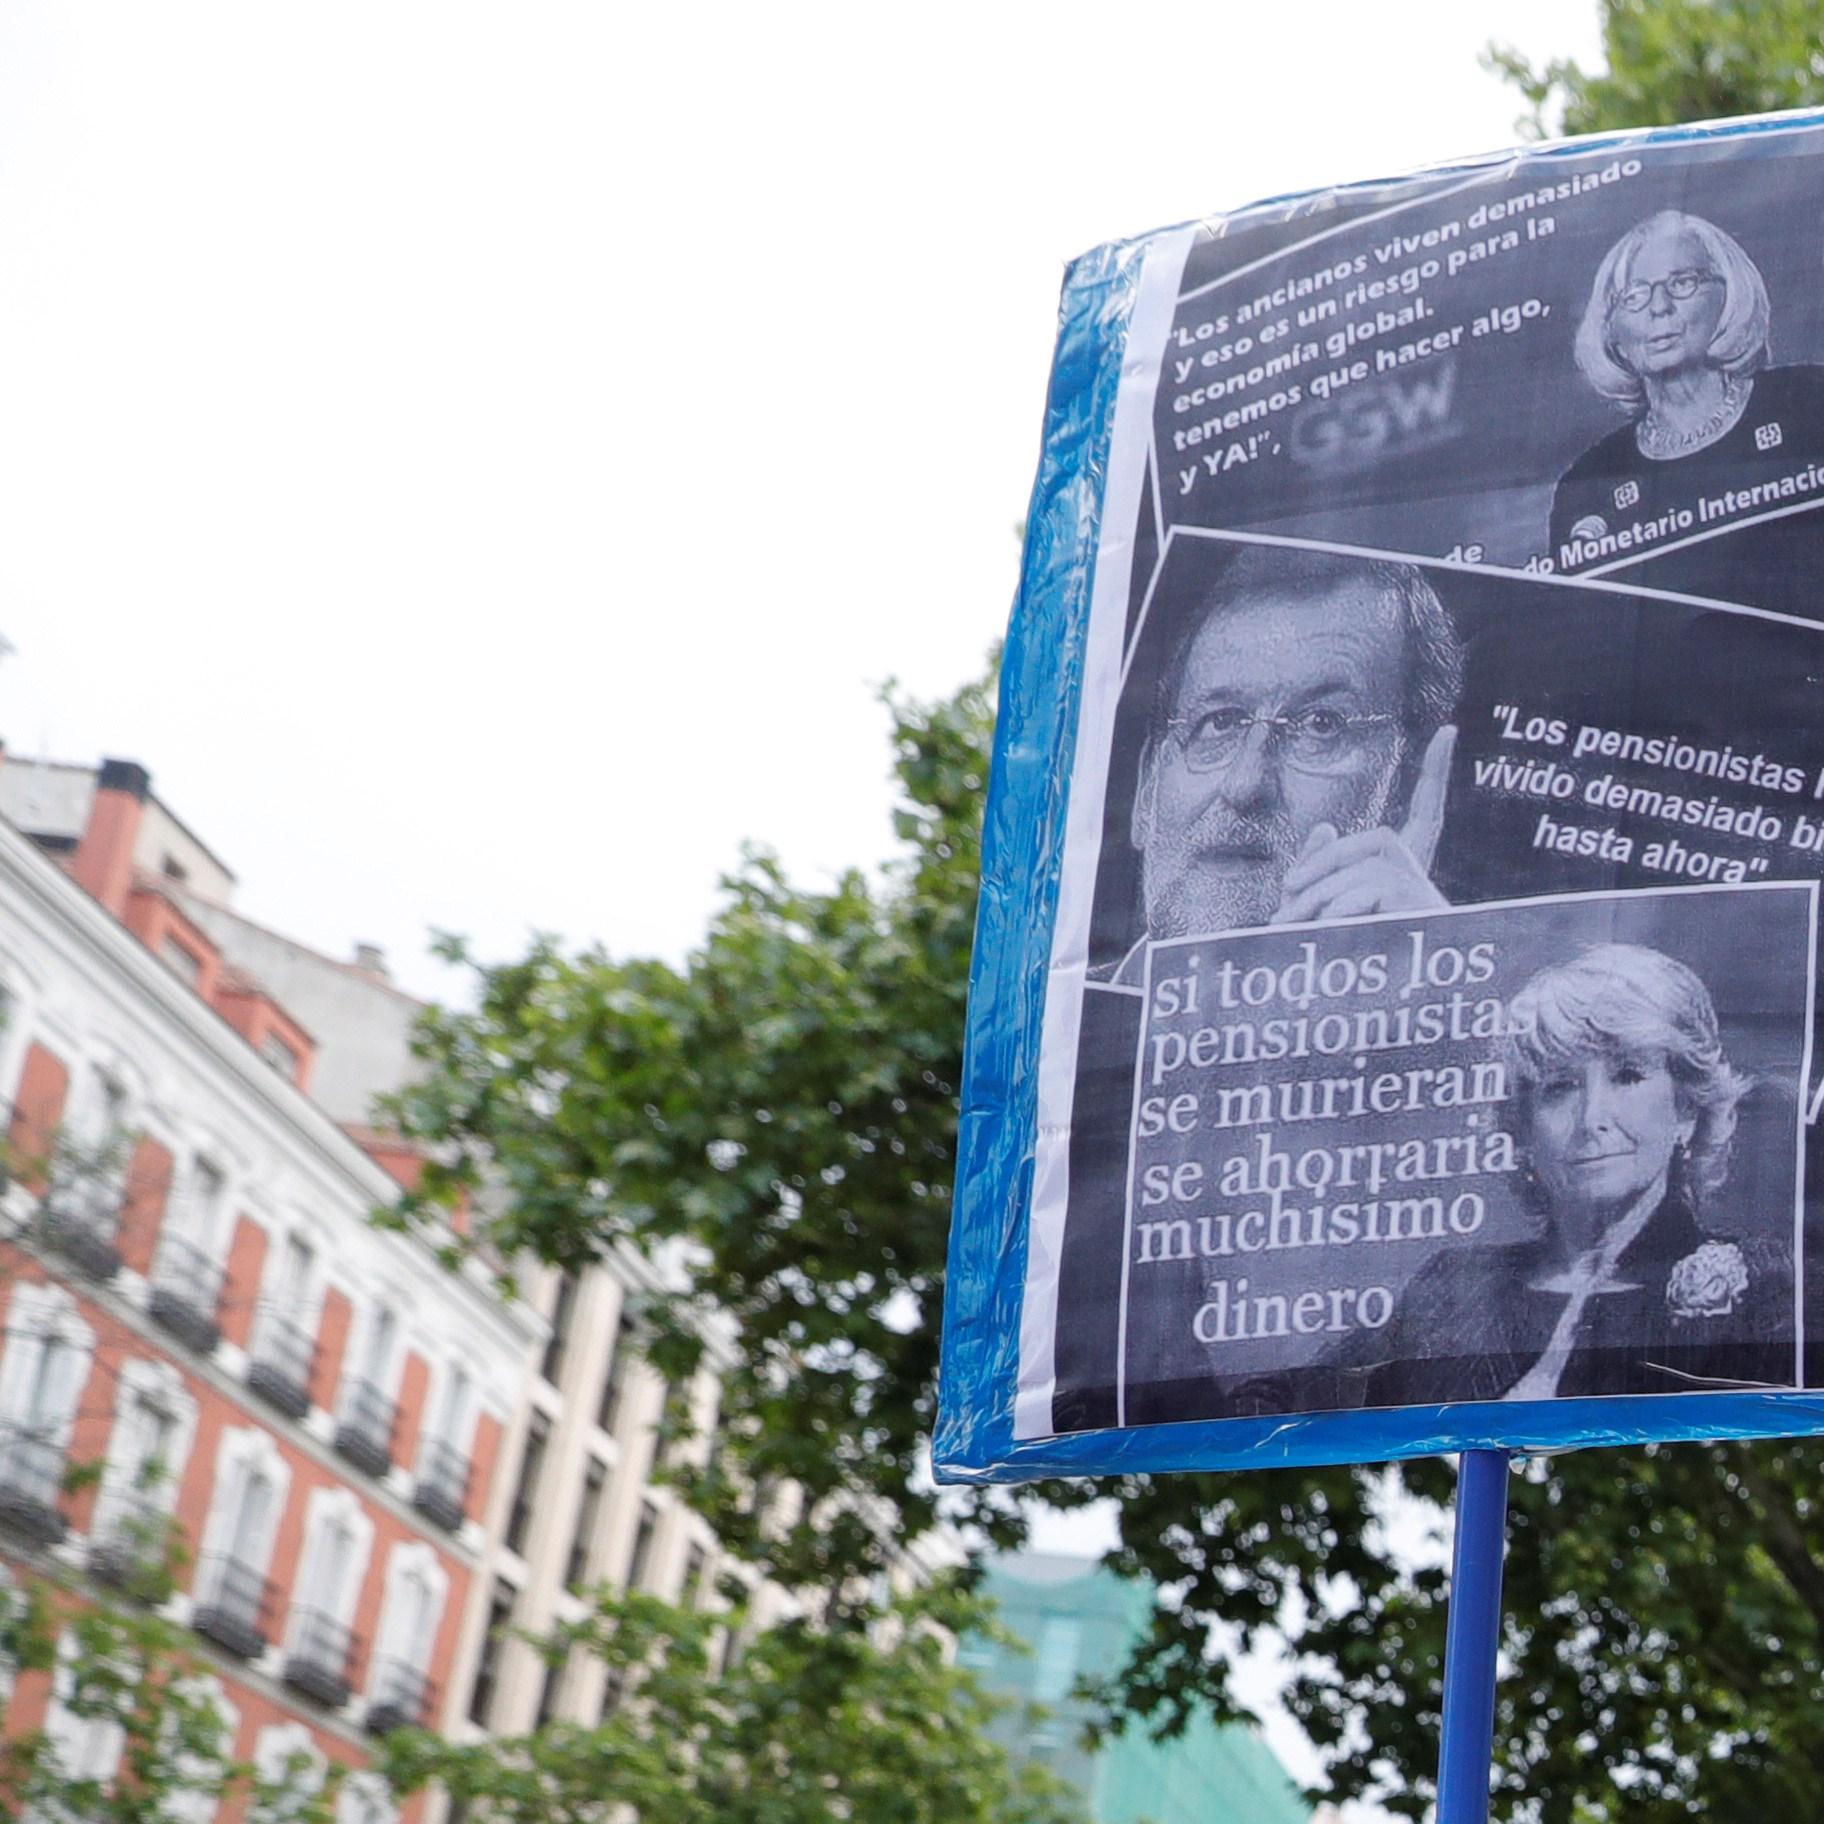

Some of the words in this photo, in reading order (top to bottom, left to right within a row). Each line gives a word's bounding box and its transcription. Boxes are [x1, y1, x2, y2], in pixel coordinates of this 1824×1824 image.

[1236, 252, 1367, 325] ancianos
[1374, 220, 1461, 265] viven
[1467, 159, 1643, 230] demasiado
[1175, 357, 1195, 384] y
[1201, 336, 1253, 368] eso
[1259, 318, 1290, 343] es
[1297, 298, 1337, 328] un
[1345, 259, 1440, 311] riesgo
[1448, 229, 1520, 276] para
[1527, 215, 1556, 241] la
[1173, 338, 1320, 413] economía
[1326, 297, 1435, 358] global.
[1173, 384, 1302, 451] tenemos
[1310, 360, 1369, 398] que
[1376, 324, 1465, 373] hacer
[1472, 299, 1551, 337] algo,
[1179, 465, 1197, 495] y
[1560, 511, 1694, 570] Monetario
[1493, 705, 1567, 745] "Los
[1572, 724, 1806, 794] pensionistas
[1474, 755, 1575, 799] vivido
[1584, 775, 1782, 841] demasiado
[1532, 814, 1633, 864] hasta
[1641, 837, 1769, 883] ahora"
[1152, 955, 1201, 1020] si
[1218, 942, 1388, 1009] todos
[1407, 931, 1496, 992] los
[1139, 1093, 1200, 1137] se
[1213, 1056, 1509, 1129] murieran
[1142, 1161, 1204, 1206] se
[1220, 1113, 1519, 1197] ahorraria
[1136, 1188, 1485, 1265] muchisimo
[1193, 1279, 1396, 1344] dinero
